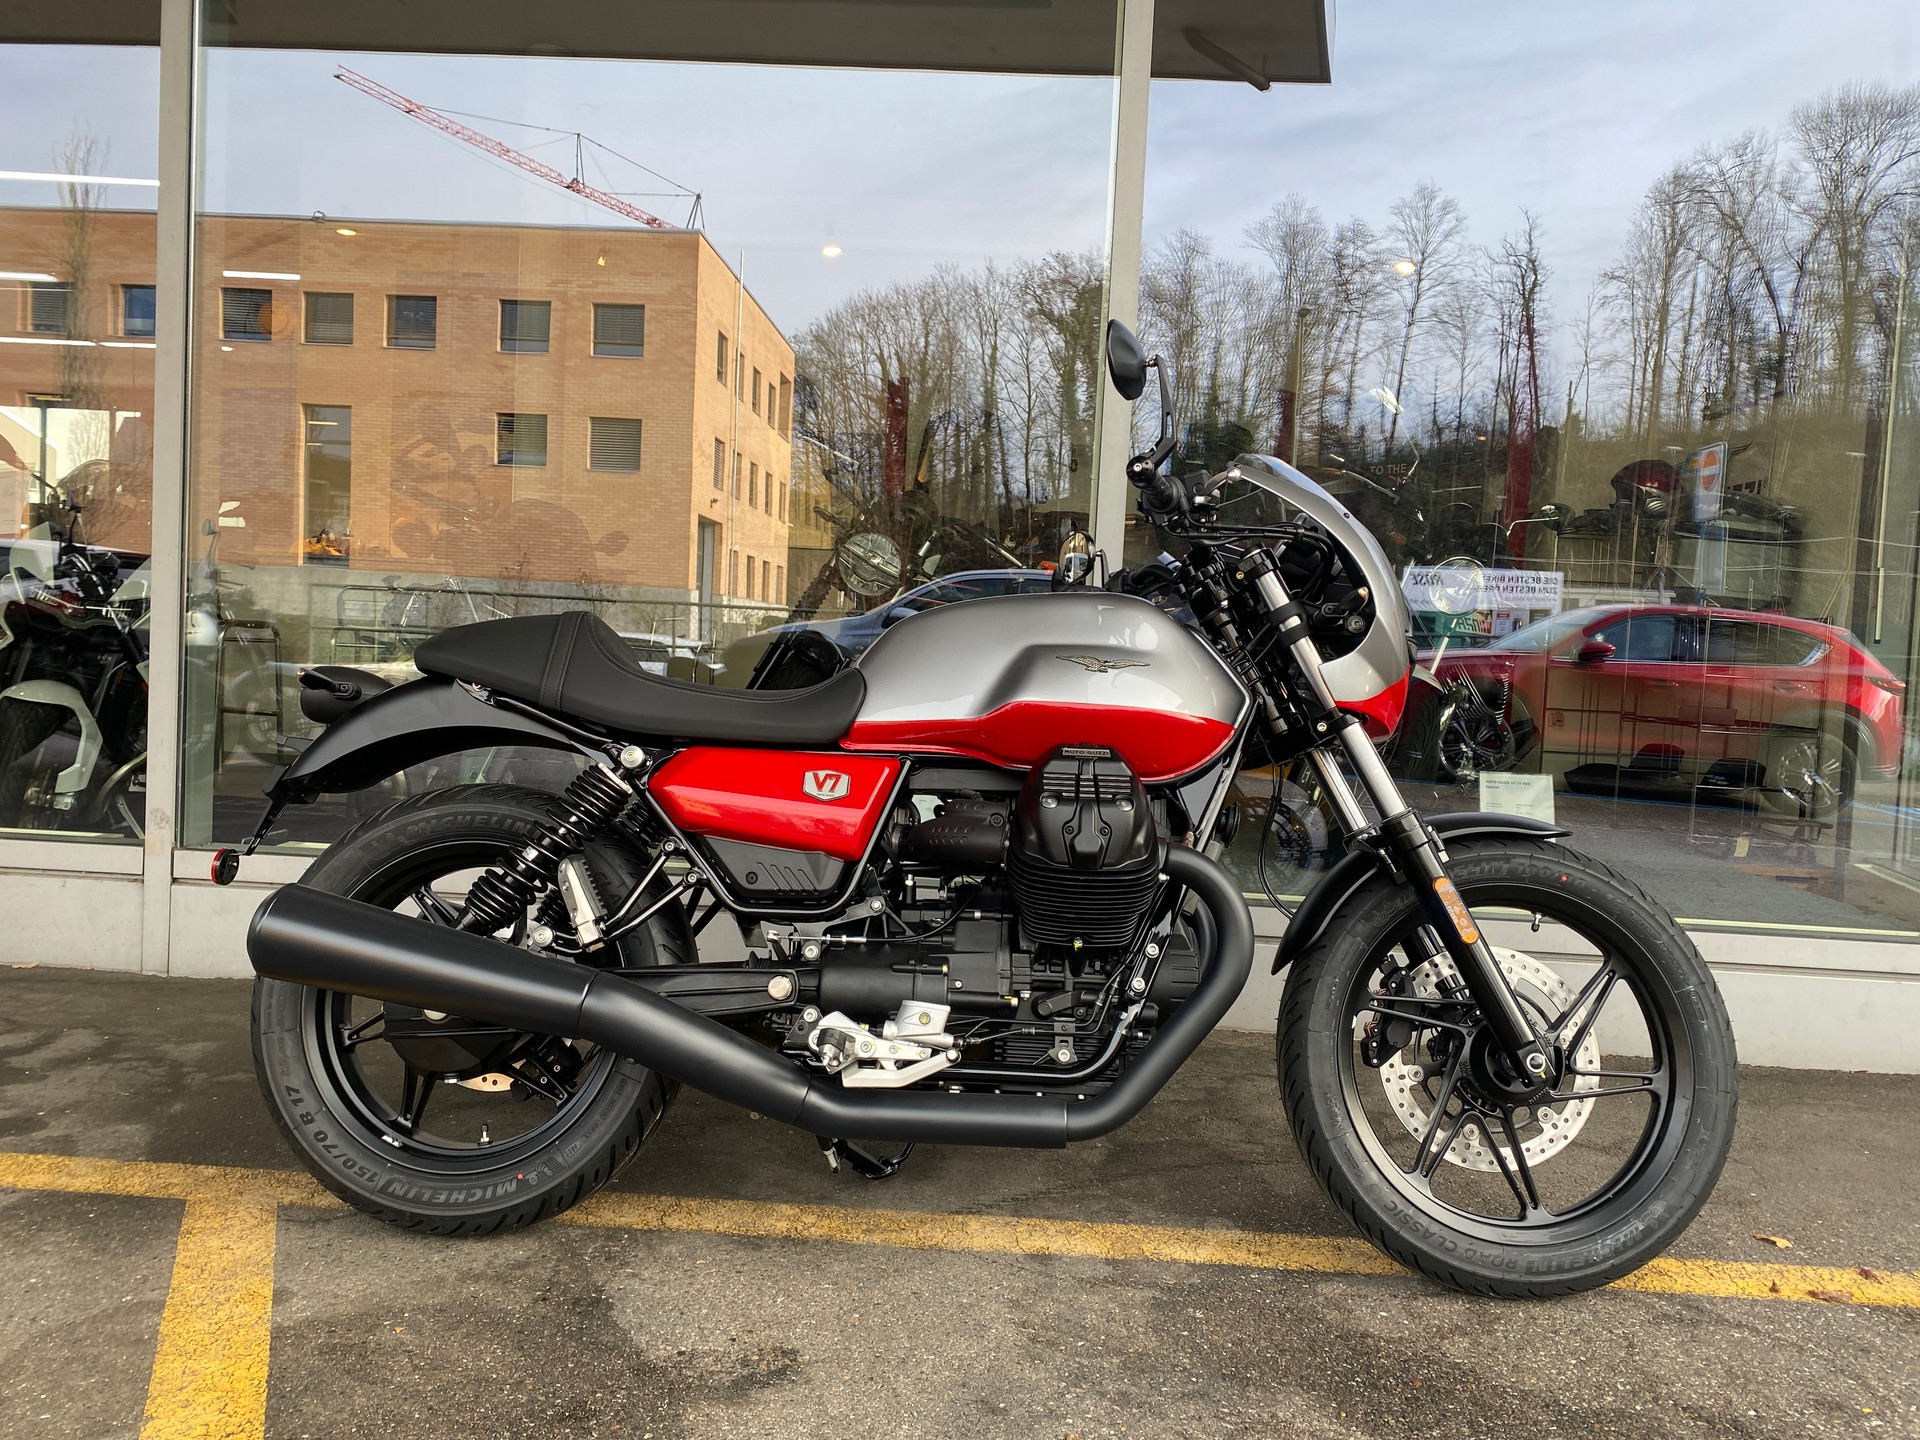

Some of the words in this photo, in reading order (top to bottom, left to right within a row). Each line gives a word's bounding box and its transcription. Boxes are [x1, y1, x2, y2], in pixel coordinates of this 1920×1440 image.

[1370, 465, 1384, 475] TO
[1387, 463, 1407, 475] THE
[812, 772, 842, 793] V7
[415, 815, 532, 835] MICHELIN
[284, 1084, 305, 1106] 17
[299, 1111, 315, 1126] B
[313, 1129, 378, 1184] 150/70
[387, 1178, 518, 1204] MICHELIN
[1382, 1198, 1458, 1256] CLASSIC
[1463, 1247, 1518, 1270] ROAD
[1531, 1224, 1643, 1275] MICHELIN
